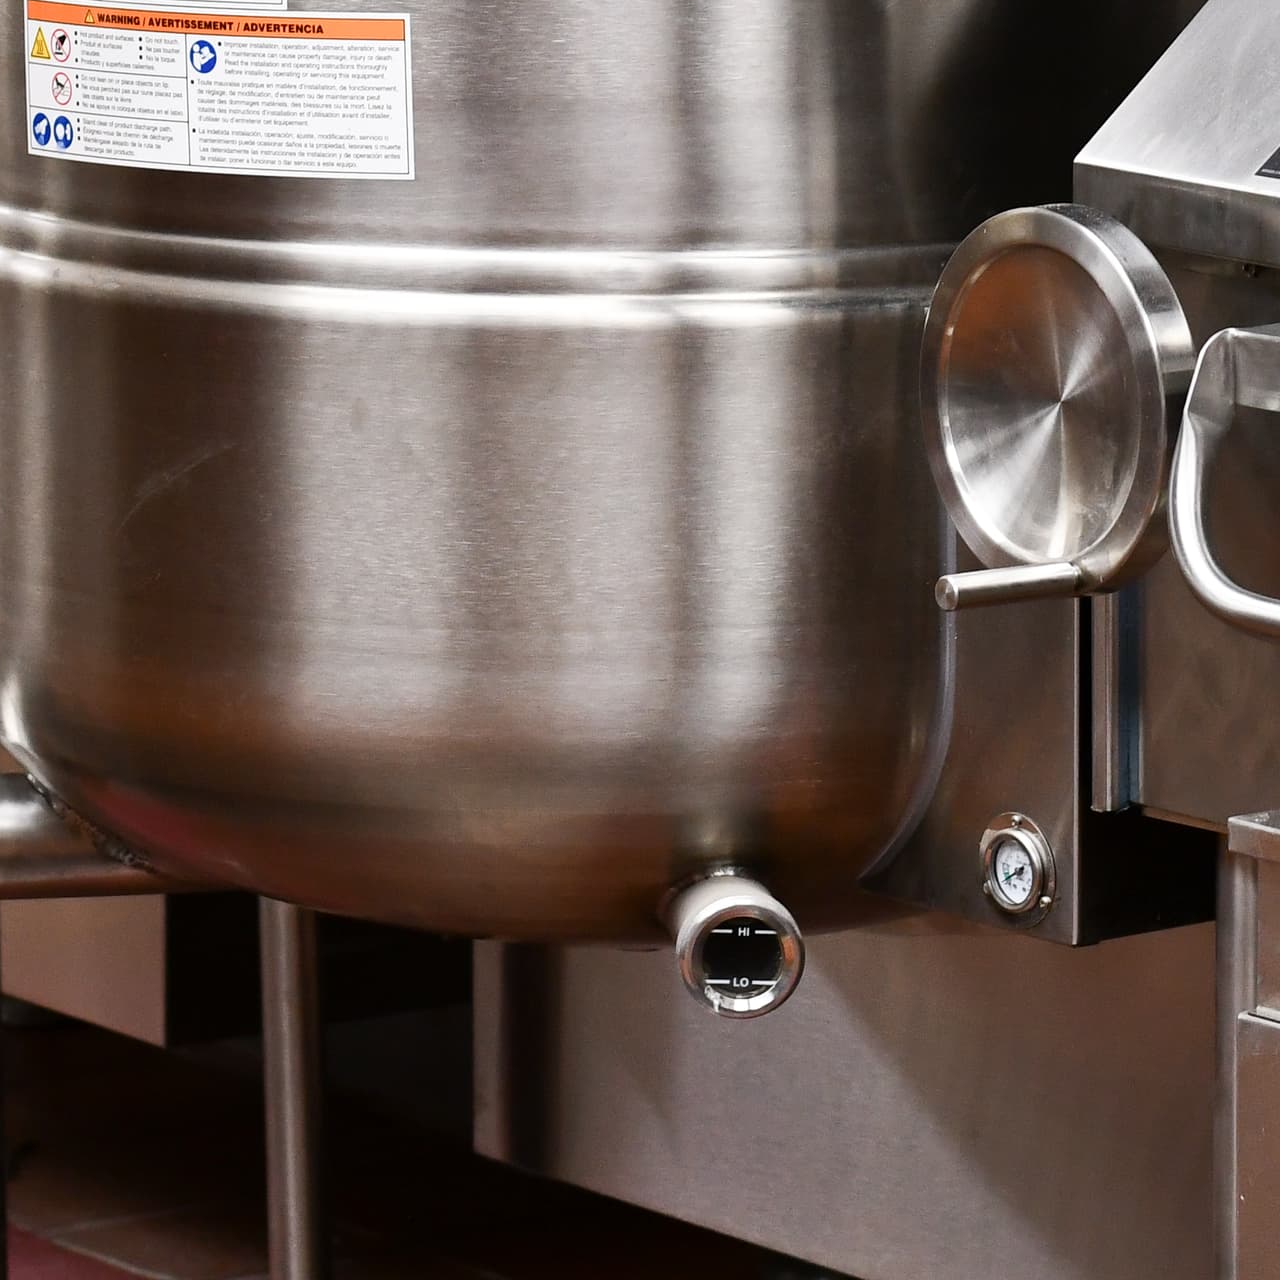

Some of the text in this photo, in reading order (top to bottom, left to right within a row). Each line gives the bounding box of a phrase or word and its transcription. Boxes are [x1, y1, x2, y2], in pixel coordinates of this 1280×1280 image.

[97, 13, 140, 25] WARNING
[148, 16, 233, 30] AVERTISSEMENT
[243, 21, 323, 35] ADVERTENCIA
[737, 927, 750, 937] HI
[733, 978, 749, 987] LO
